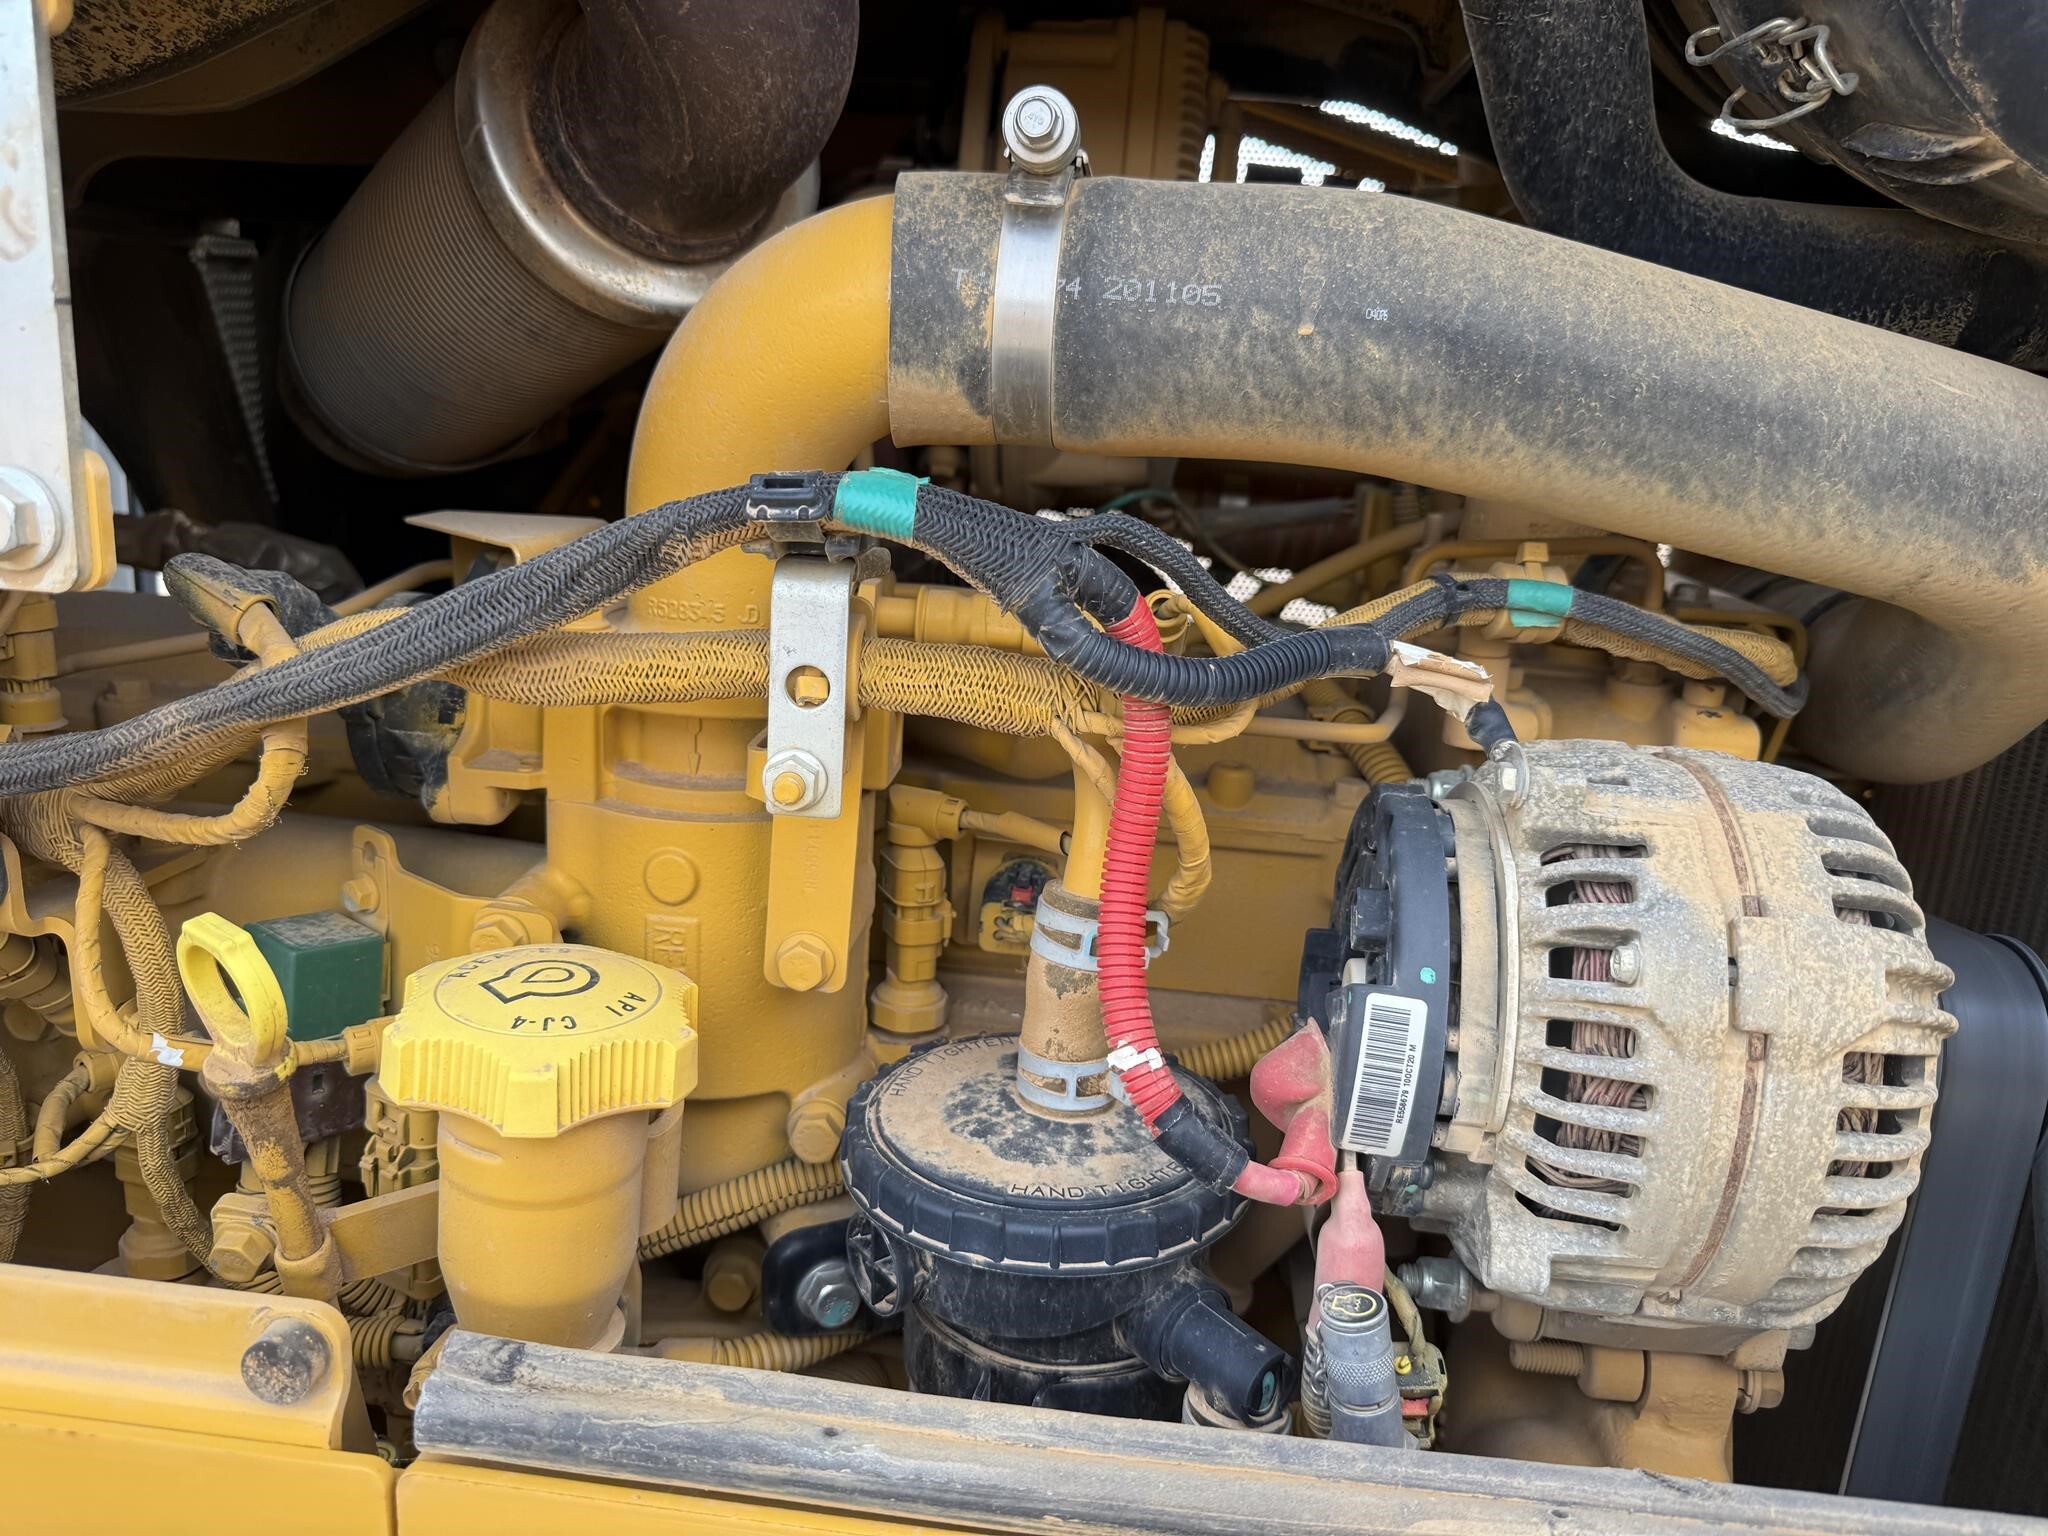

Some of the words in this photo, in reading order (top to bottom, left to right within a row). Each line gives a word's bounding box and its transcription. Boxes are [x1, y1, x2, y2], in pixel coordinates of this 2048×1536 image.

[1102, 277, 1222, 306] 201105
[605, 991, 646, 1017] API
[510, 1014, 577, 1031] CJ-4
[889, 1066, 924, 1096] HAND
[920, 1036, 1014, 1065] TIGHTEN
[1010, 1183, 1084, 1200] HAND
[1095, 1161, 1192, 1197] TIGHTE
